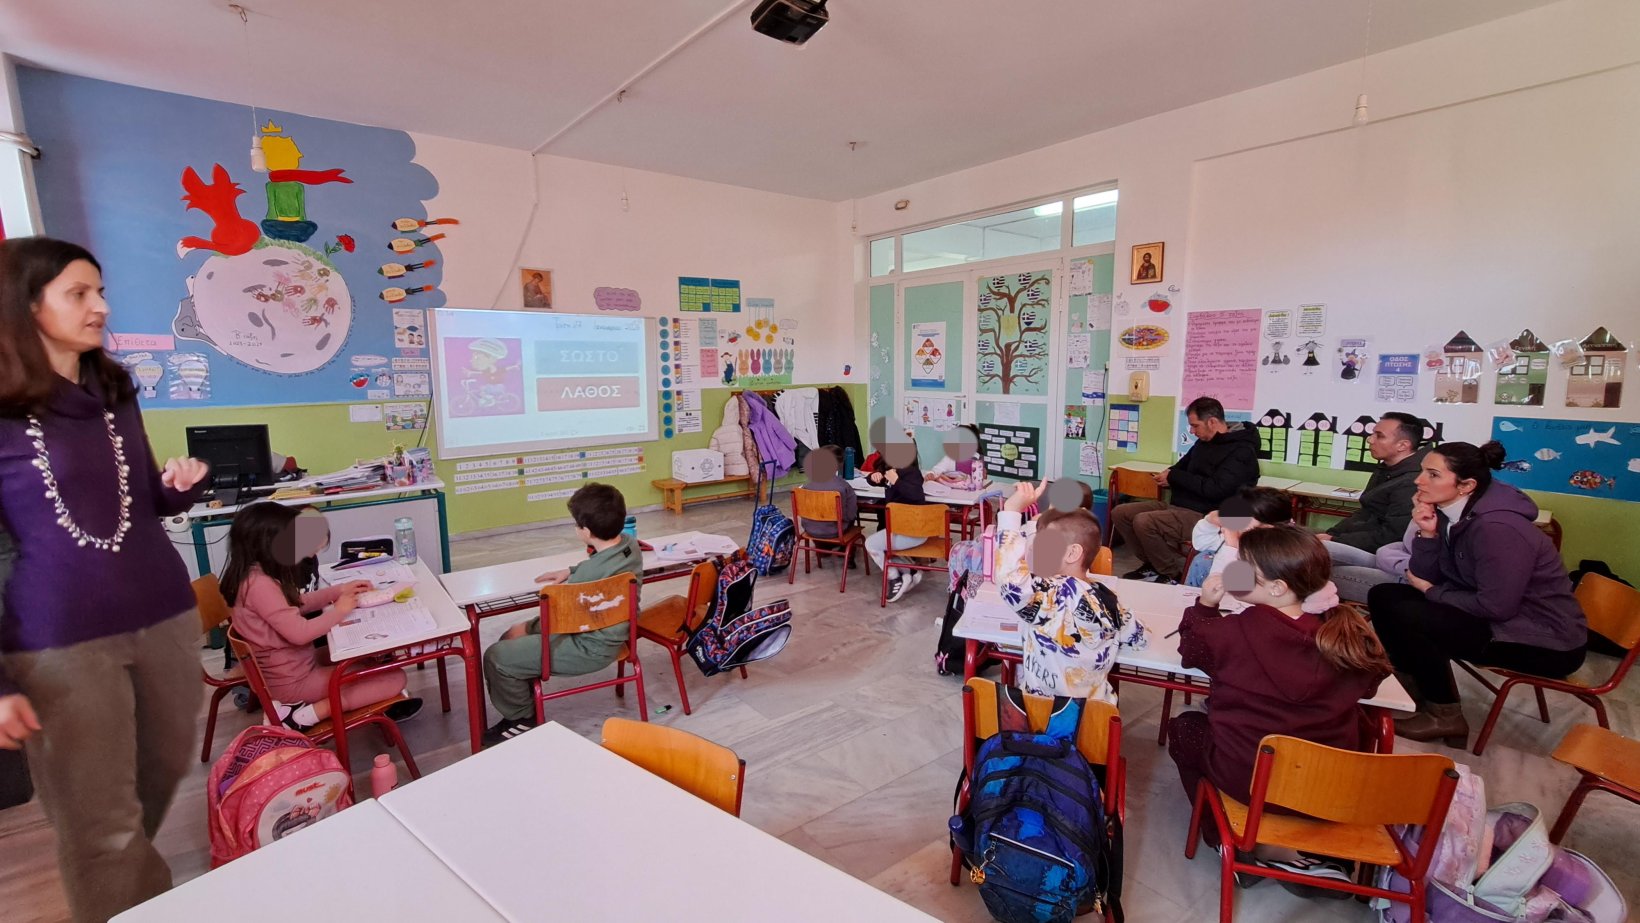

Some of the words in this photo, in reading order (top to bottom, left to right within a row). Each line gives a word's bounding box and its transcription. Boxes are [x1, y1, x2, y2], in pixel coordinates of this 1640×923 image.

[560, 350, 618, 362] ΣΩΣΤΟ
[561, 385, 621, 399] ΛΑΘΟΣ
[1025, 655, 1058, 689] AKERS
